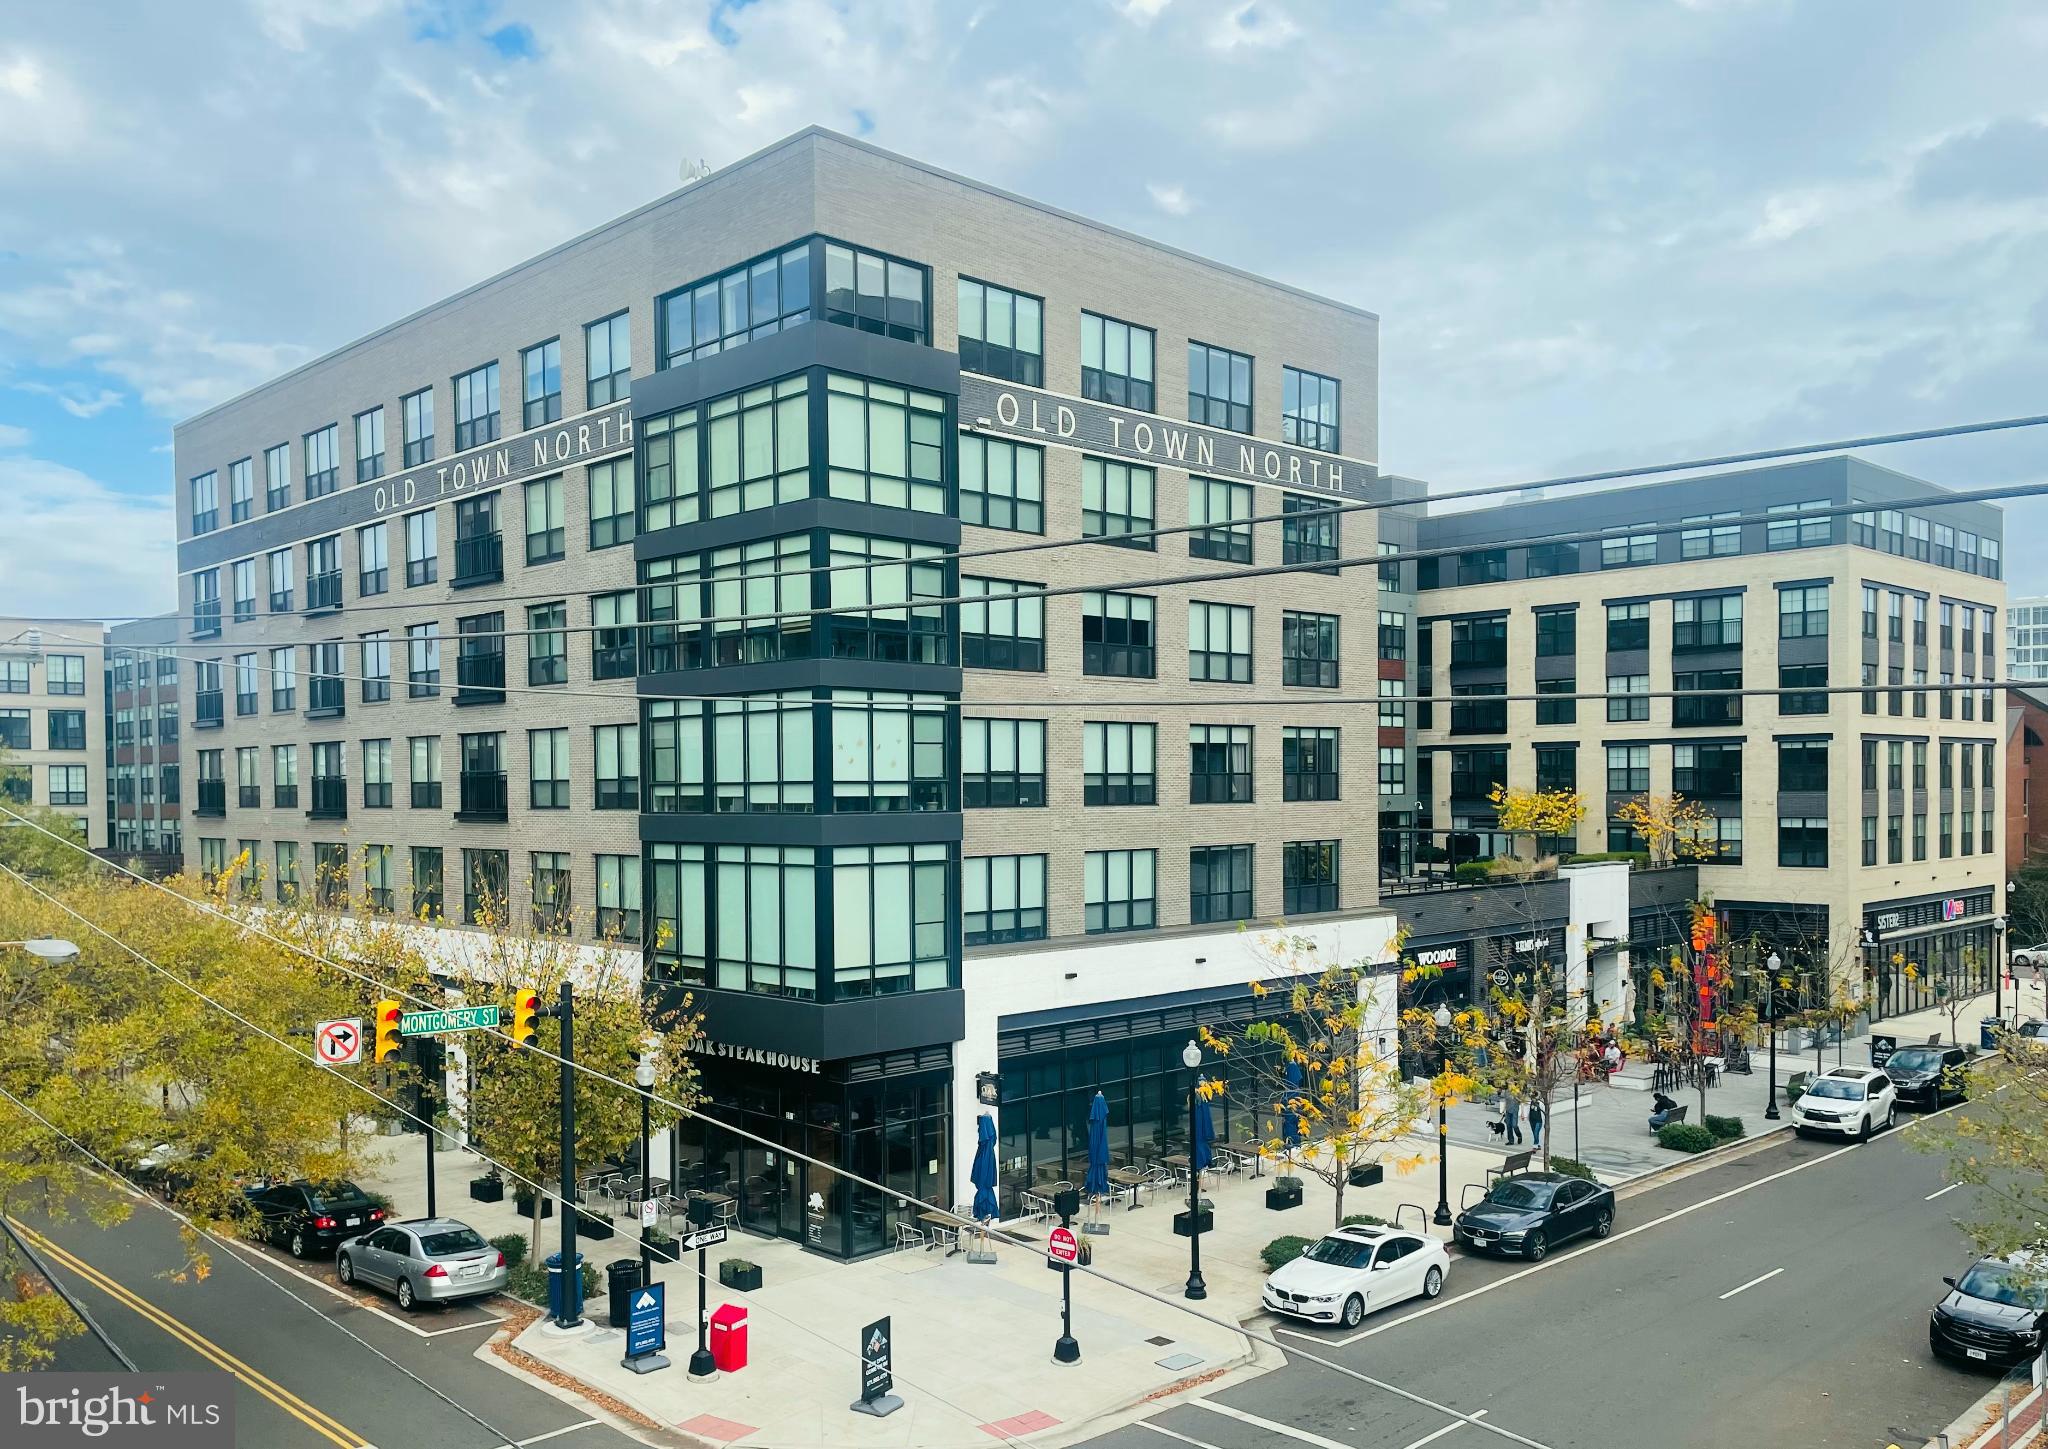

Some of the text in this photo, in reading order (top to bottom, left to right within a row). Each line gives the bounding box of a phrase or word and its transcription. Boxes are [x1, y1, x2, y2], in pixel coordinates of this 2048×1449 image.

[996, 393, 1343, 492] OLD TOWN NORTH
[374, 410, 633, 513] OLD TOWN NORTH
[401, 1008, 495, 1033] MONTGOMERY ST
[686, 1036, 821, 1075] OAK STEAKHOUSE
[695, 1231, 724, 1244] ONE WAY
[1055, 1248, 1071, 1257] ENTER
